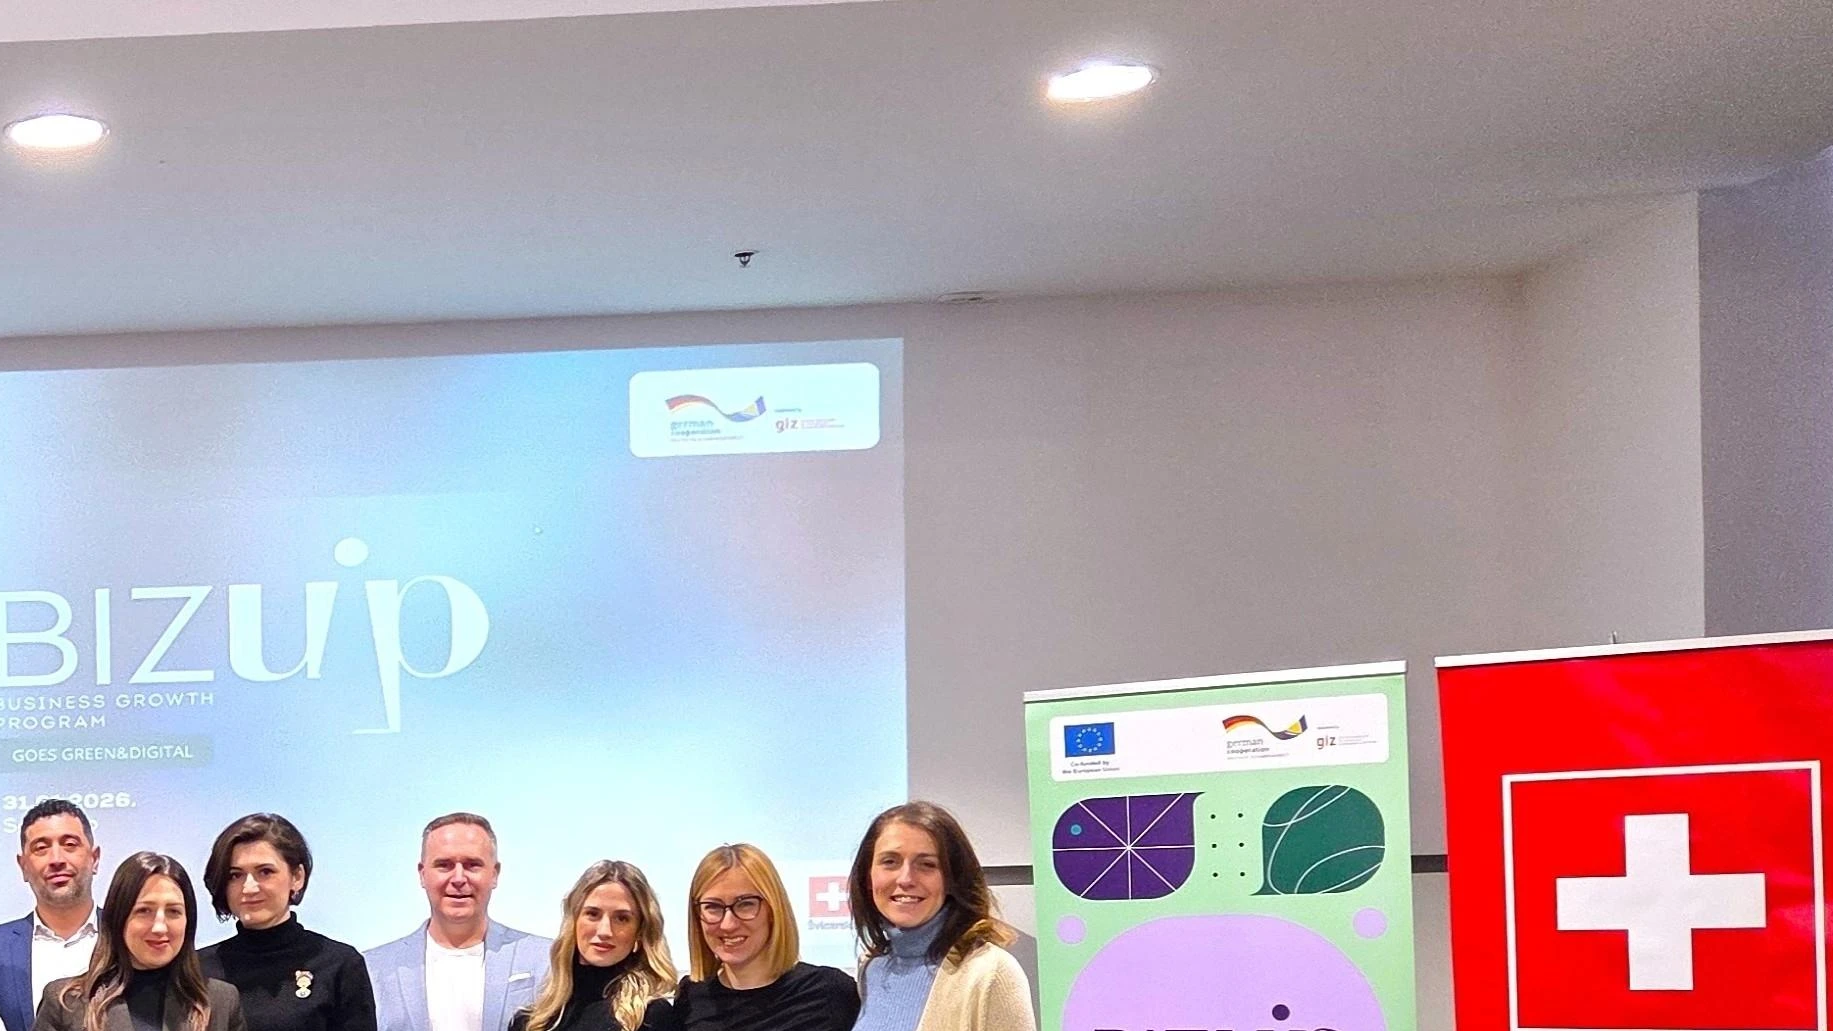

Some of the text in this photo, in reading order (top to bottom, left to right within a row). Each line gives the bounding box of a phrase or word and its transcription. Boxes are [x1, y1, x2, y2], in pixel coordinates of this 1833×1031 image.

[115, 691, 214, 709] GROWTH
[1317, 735, 1337, 750] giz
[11, 744, 194, 763] GOES GREEN&DIGITAL
